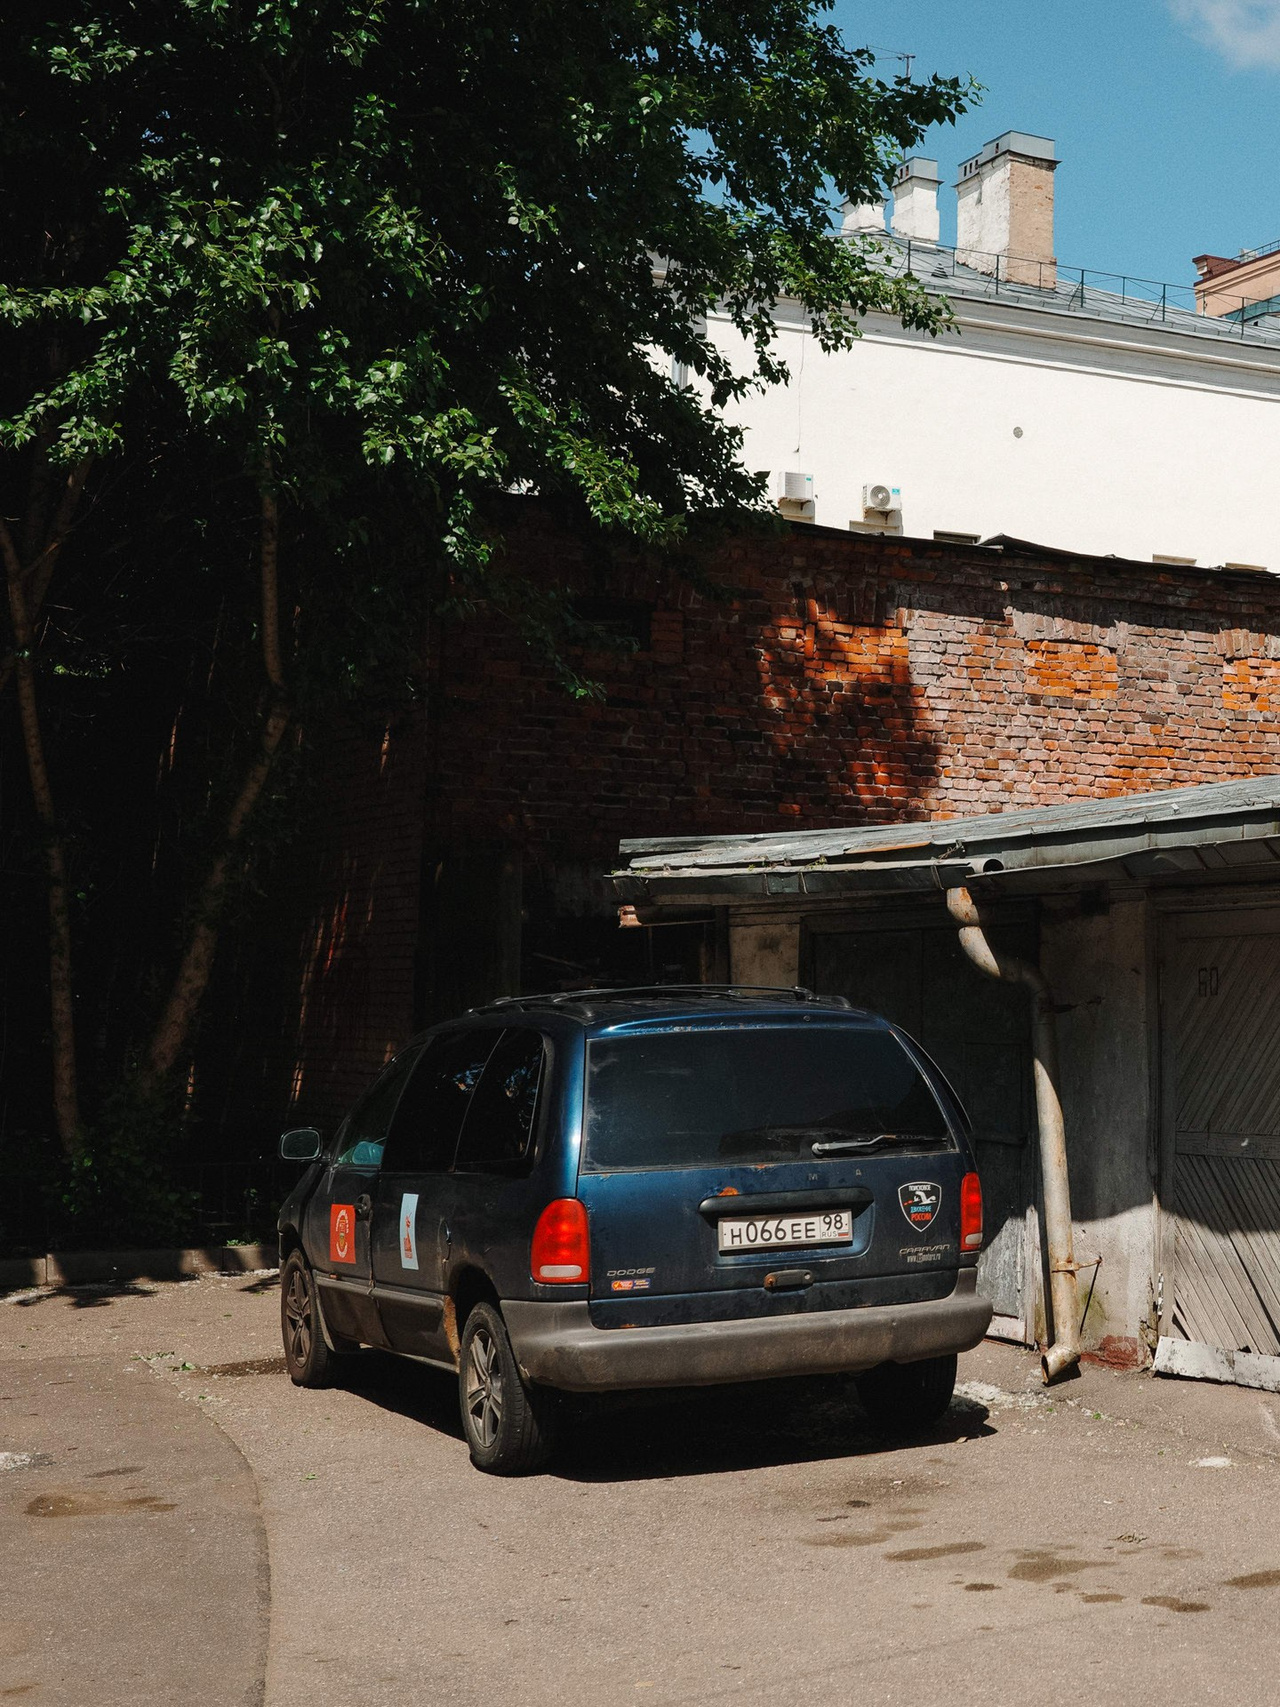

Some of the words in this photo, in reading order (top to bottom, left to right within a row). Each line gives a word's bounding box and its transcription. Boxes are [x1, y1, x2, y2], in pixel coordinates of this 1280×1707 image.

[822, 1214, 843, 1231] 98
[899, 1244, 950, 1255] CARAVAN
[606, 1267, 656, 1277] DODGE
